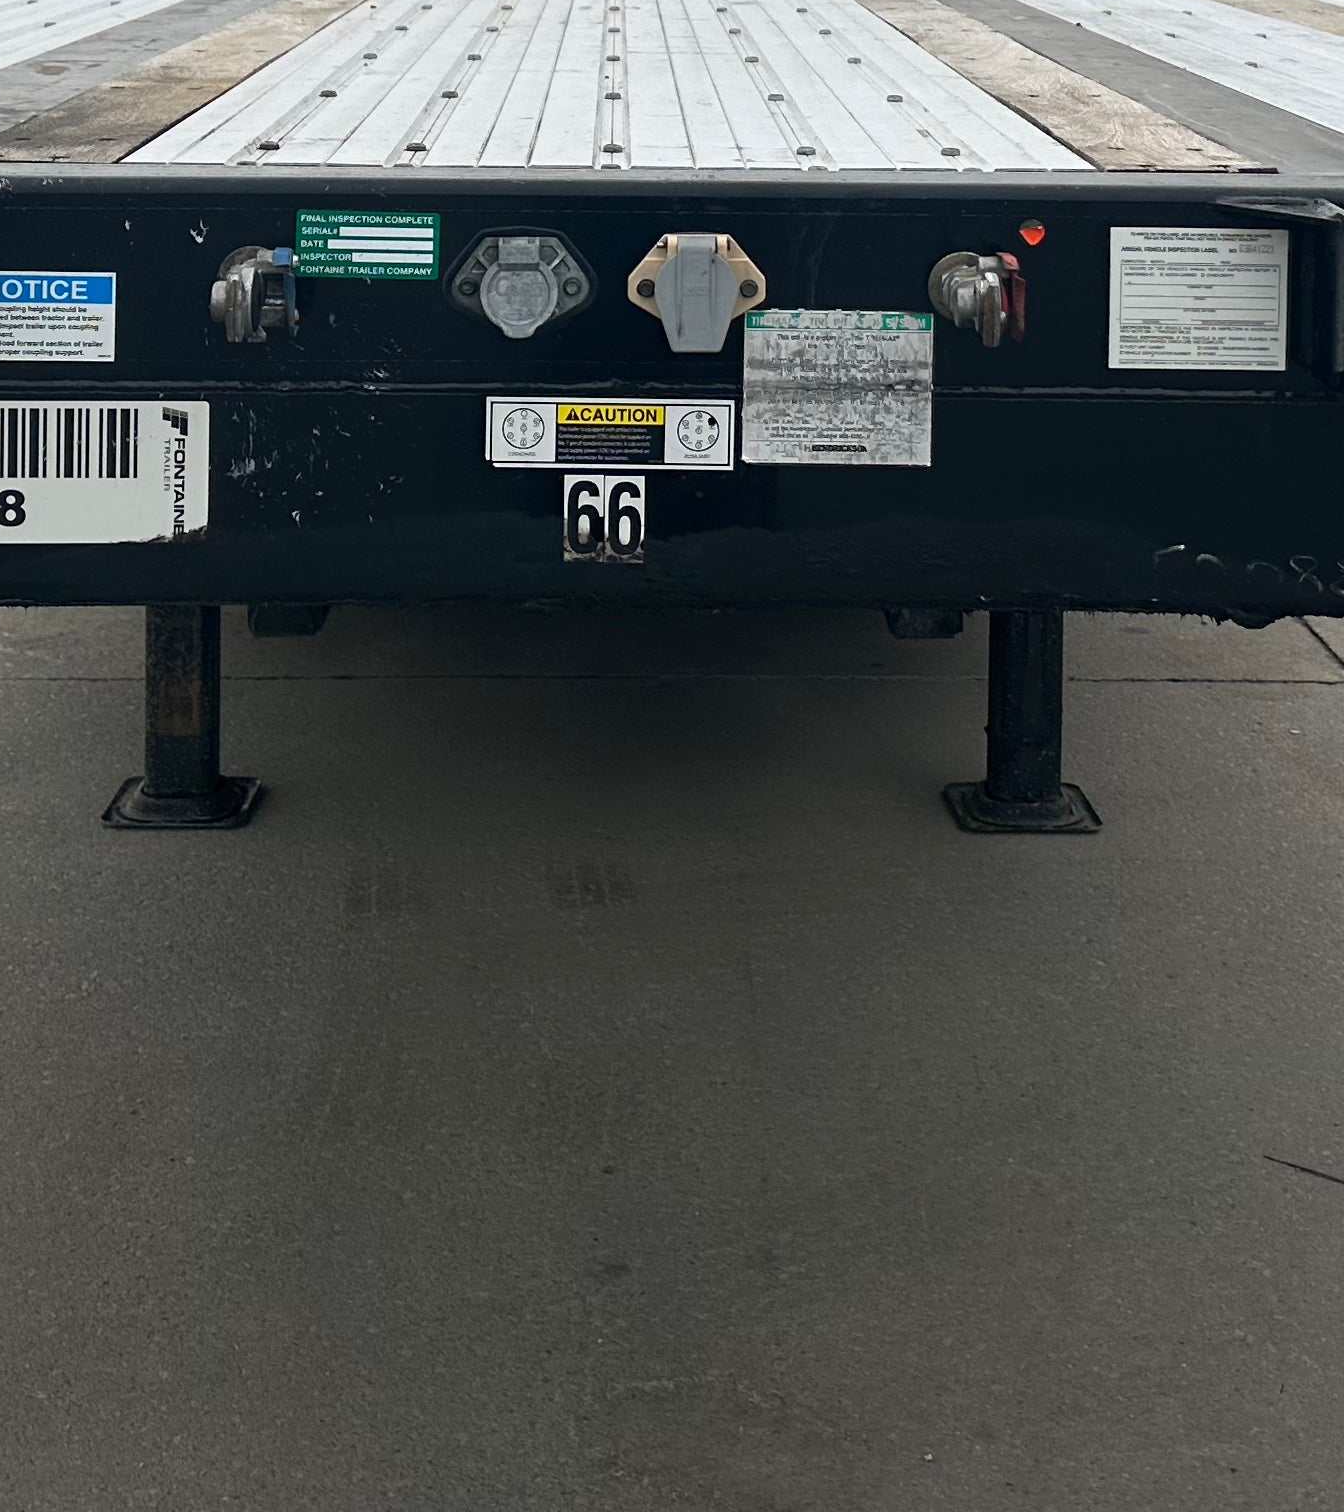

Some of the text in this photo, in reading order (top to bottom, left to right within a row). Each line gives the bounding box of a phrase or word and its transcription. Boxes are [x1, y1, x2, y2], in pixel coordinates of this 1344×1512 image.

[300, 214, 433, 225] FINAL INSPECTION COMPLETE
[301, 226, 337, 235] SERIAL#
[300, 239, 324, 248] DATE
[300, 252, 351, 261] INSPECTOR
[300, 264, 432, 276] FONTAINE TRAILER COMPANY
[580, 407, 657, 423] CAUTION
[163, 437, 171, 492] TRAILER
[174, 438, 186, 537] FONTAINE
[567, 480, 642, 555] 66
